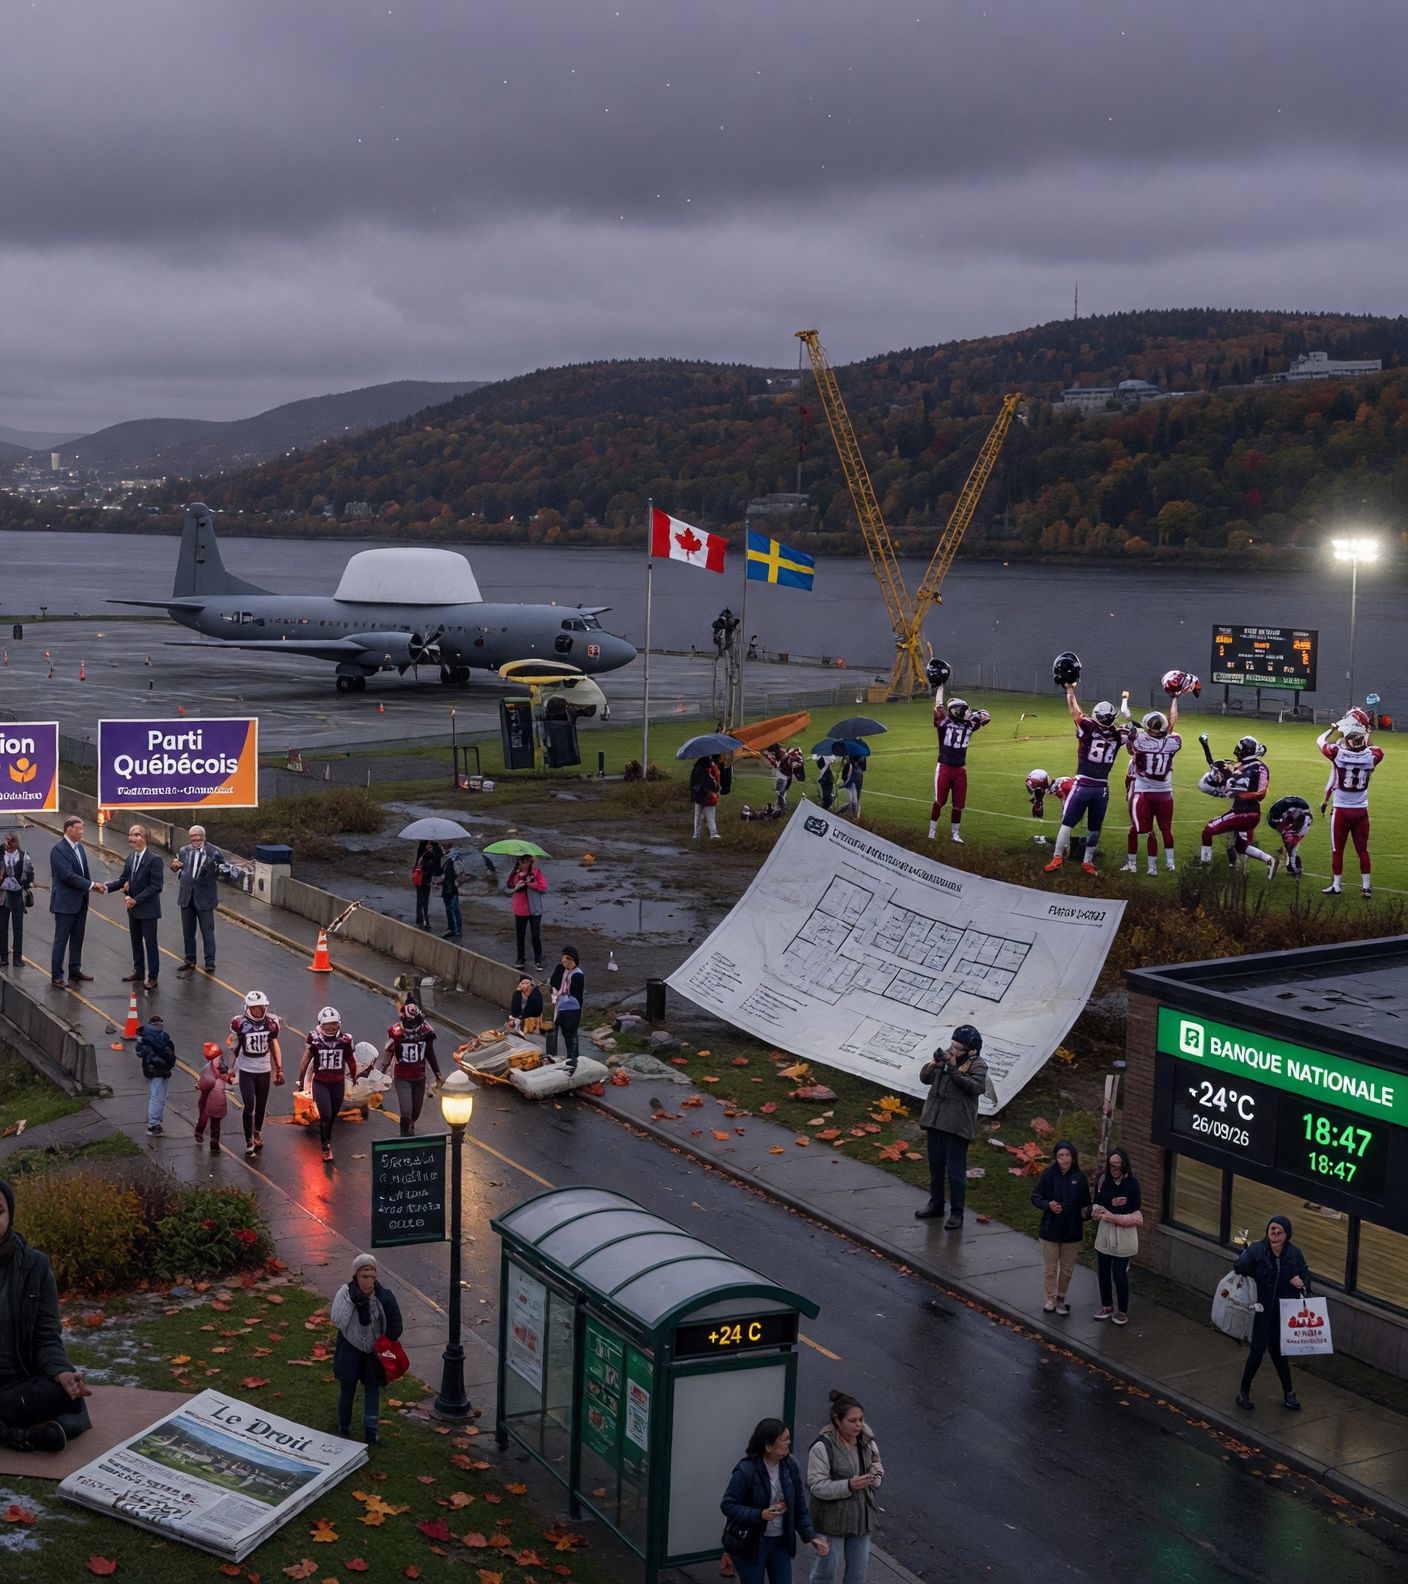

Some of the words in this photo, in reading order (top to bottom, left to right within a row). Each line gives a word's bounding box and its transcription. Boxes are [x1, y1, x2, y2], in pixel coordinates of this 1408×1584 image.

[148, 729, 203, 751] Parti
[113, 752, 239, 780] Québécois
[1210, 1037, 1282, 1074] BANQUE
[1287, 1059, 1394, 1107] NATIONALE
[1192, 1114, 1250, 1146] 26/09/26
[1303, 1111, 1372, 1157] 18:47
[1309, 1152, 1357, 1182] 18:47
[708, 1324, 743, 1345] +24
[748, 1322, 762, 1341] C
[210, 1404, 242, 1425] Le
[245, 1418, 312, 1452] Droit
